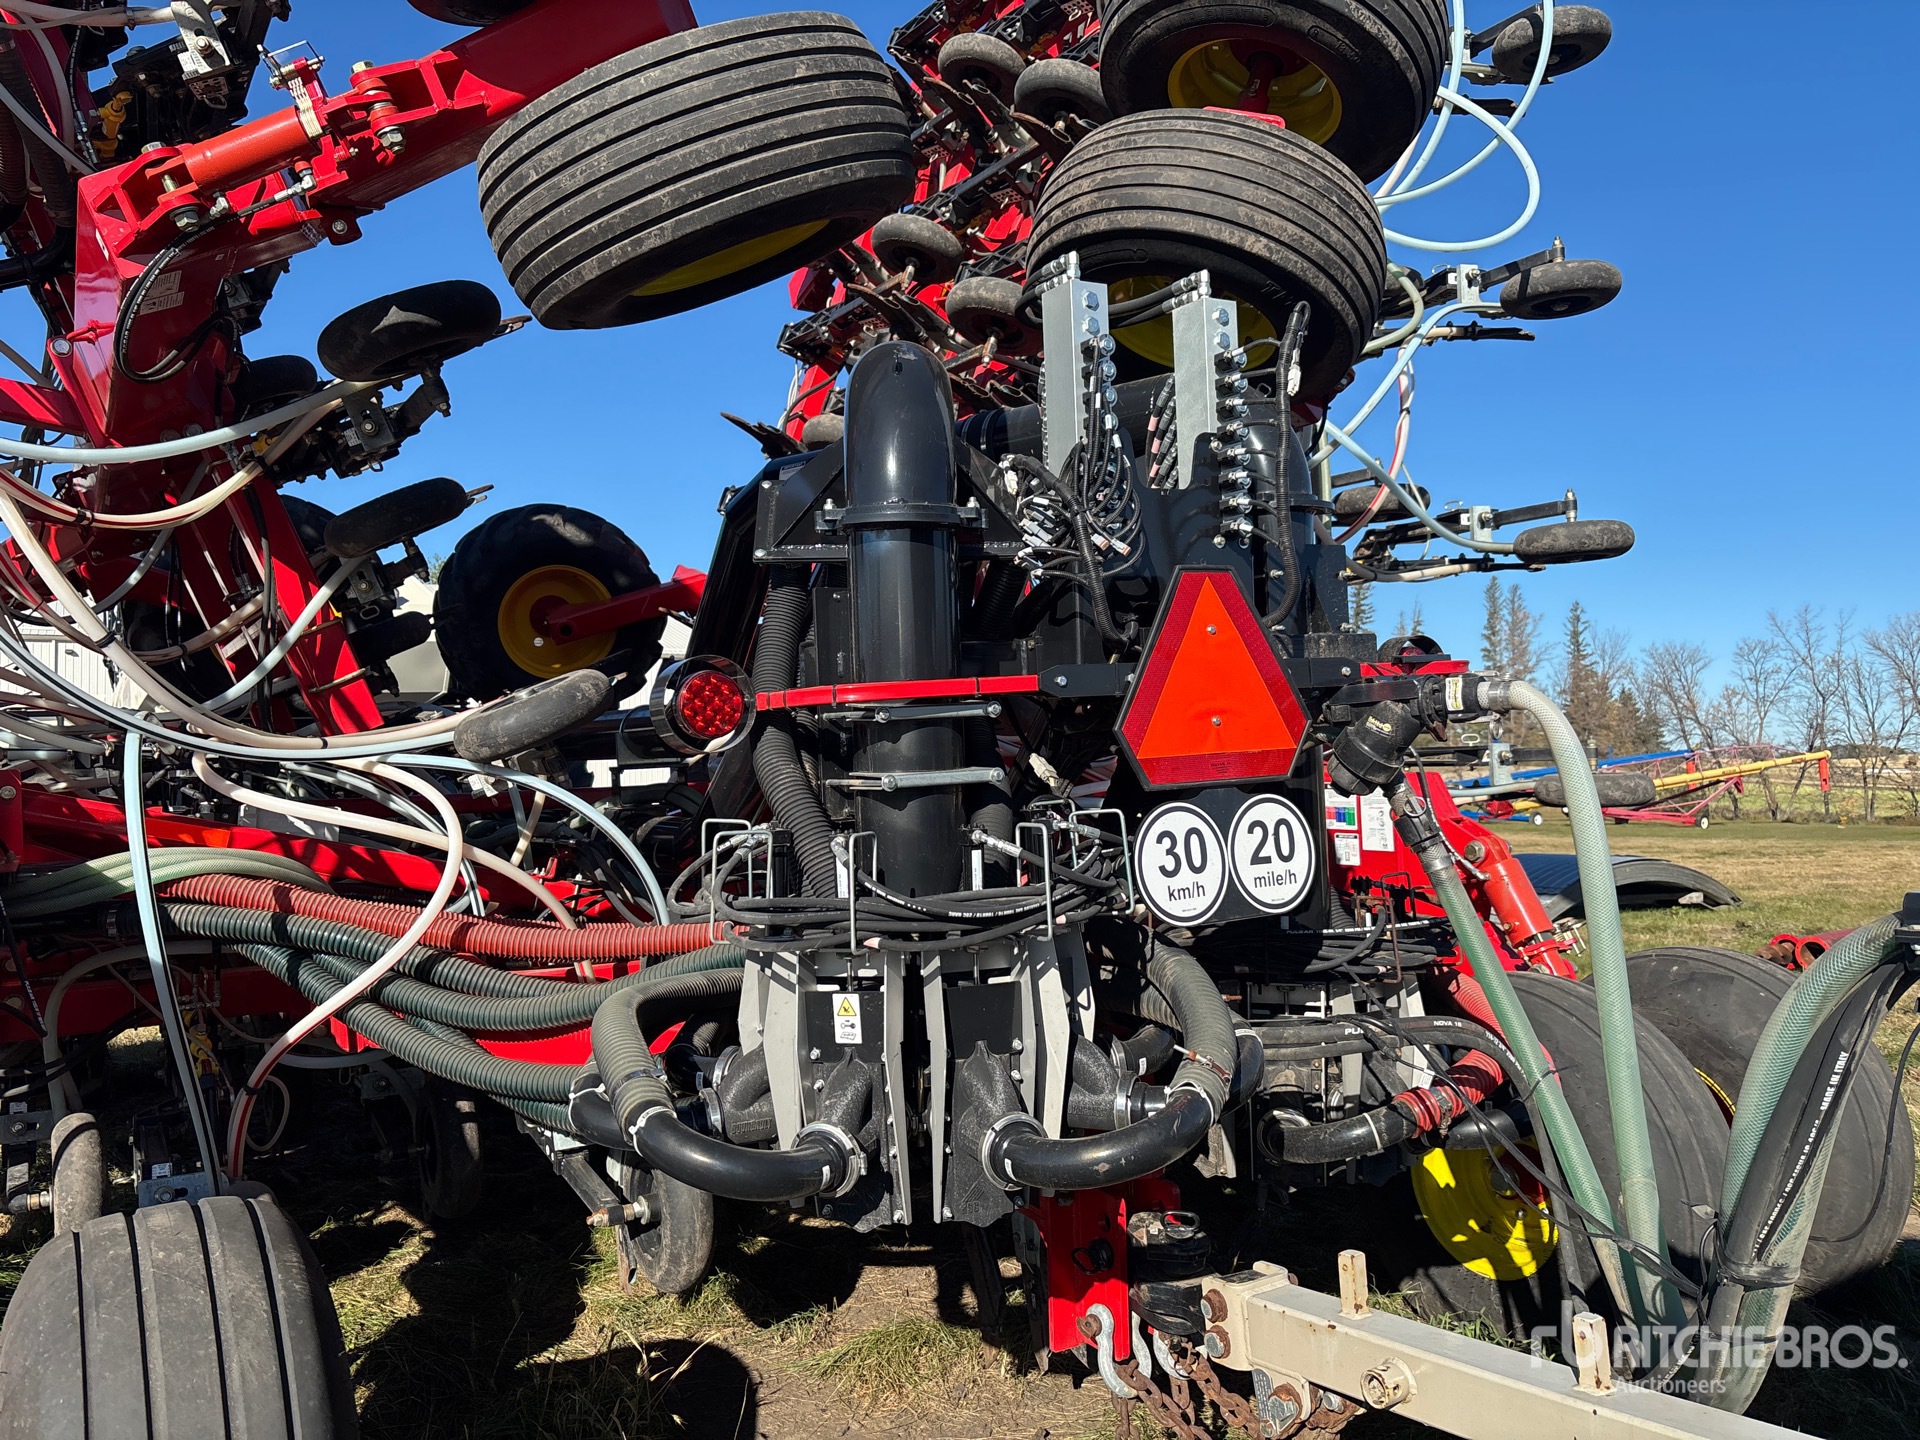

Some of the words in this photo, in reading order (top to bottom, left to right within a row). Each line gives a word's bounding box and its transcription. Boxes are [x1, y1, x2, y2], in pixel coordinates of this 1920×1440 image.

[1246, 817, 1296, 866] 20
[1155, 826, 1208, 879] 30
[1253, 869, 1298, 889] mile/h
[1167, 881, 1206, 902] km/h
[1833, 1051, 1849, 1072] ITALY
[1829, 1074, 1840, 1085] IN
